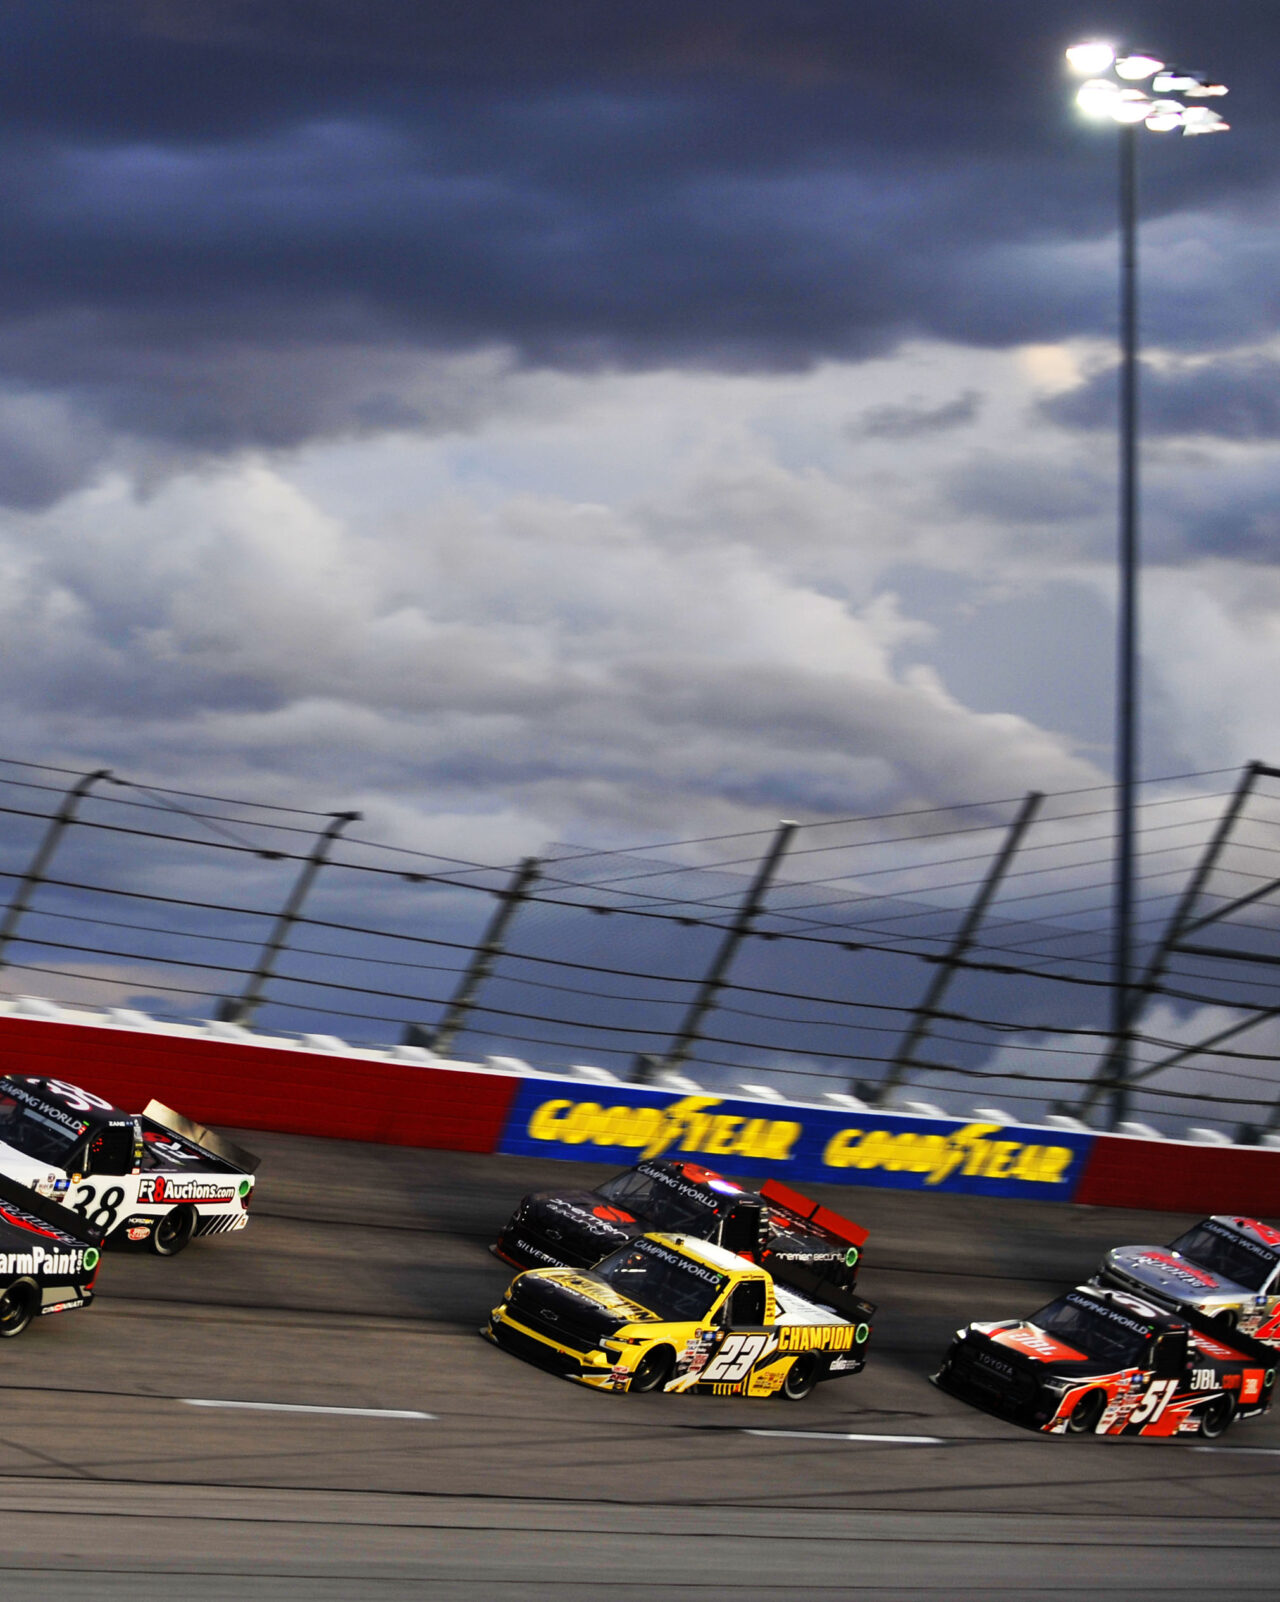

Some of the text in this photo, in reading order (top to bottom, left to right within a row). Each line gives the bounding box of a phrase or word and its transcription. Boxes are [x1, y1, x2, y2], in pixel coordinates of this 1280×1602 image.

[38, 1101, 84, 1131] WORLD
[528, 1095, 802, 1160] GOODYEAR
[823, 1122, 1073, 1185] GOODYEAR
[138, 1176, 237, 1204] FR8Auctions.com
[637, 1164, 718, 1208] CAMPING WORLD
[73, 1185, 126, 1236] 38
[517, 1239, 572, 1269] SILVERAD
[634, 1240, 721, 1285] CAMPING WORLD
[1066, 1294, 1149, 1335] CAMPING WORLD
[701, 1335, 768, 1381] 23
[778, 1326, 855, 1351] CHAMPION
[977, 1352, 1014, 1376] TOYOTA
[1129, 1379, 1180, 1424] 51
